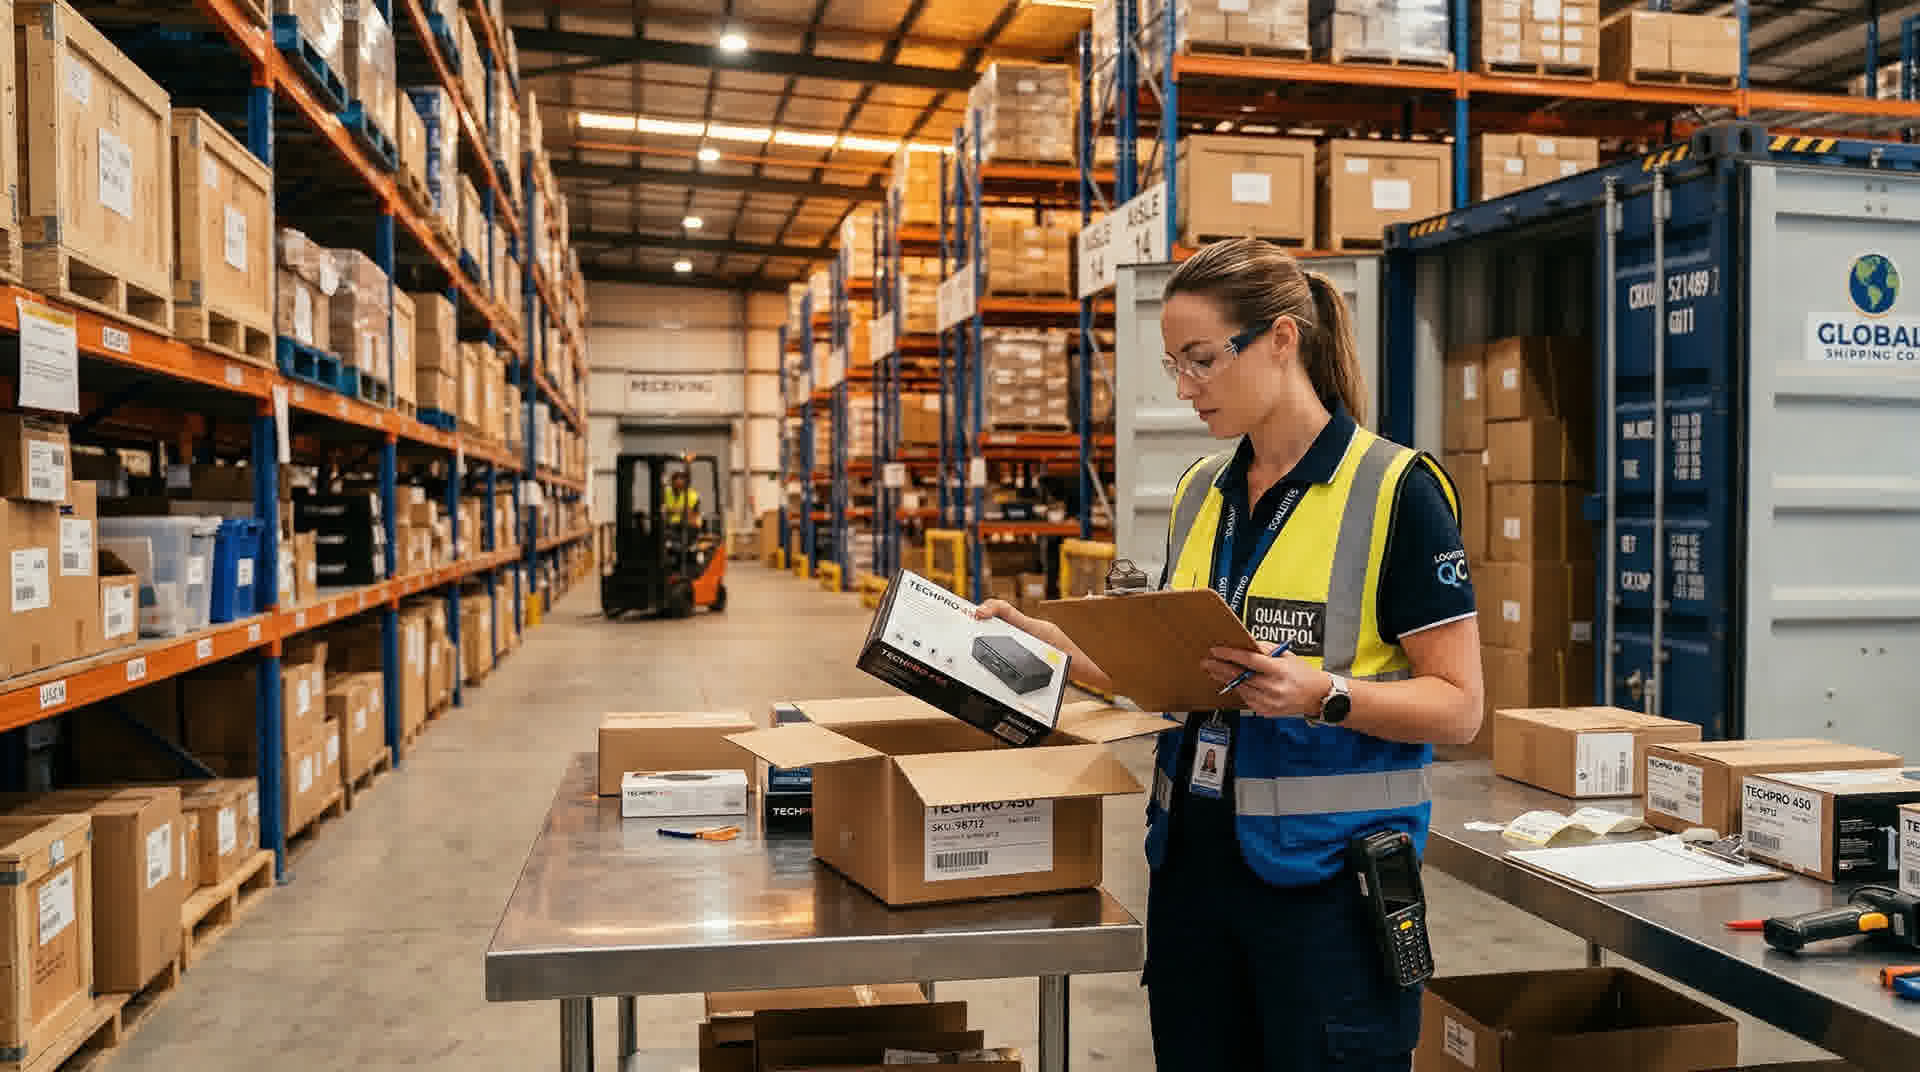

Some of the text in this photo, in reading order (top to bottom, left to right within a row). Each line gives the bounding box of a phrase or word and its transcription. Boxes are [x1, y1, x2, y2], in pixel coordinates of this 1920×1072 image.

[1818, 322, 1920, 347] GLOBAL
[1824, 348, 1891, 361] SHIPPING
[1438, 559, 1468, 586] QC
[908, 580, 960, 610] TECHPRO
[1255, 607, 1315, 627] QUALITY
[1251, 624, 1319, 645] CONTROL
[1745, 785, 1812, 811] TECHPRO 450
